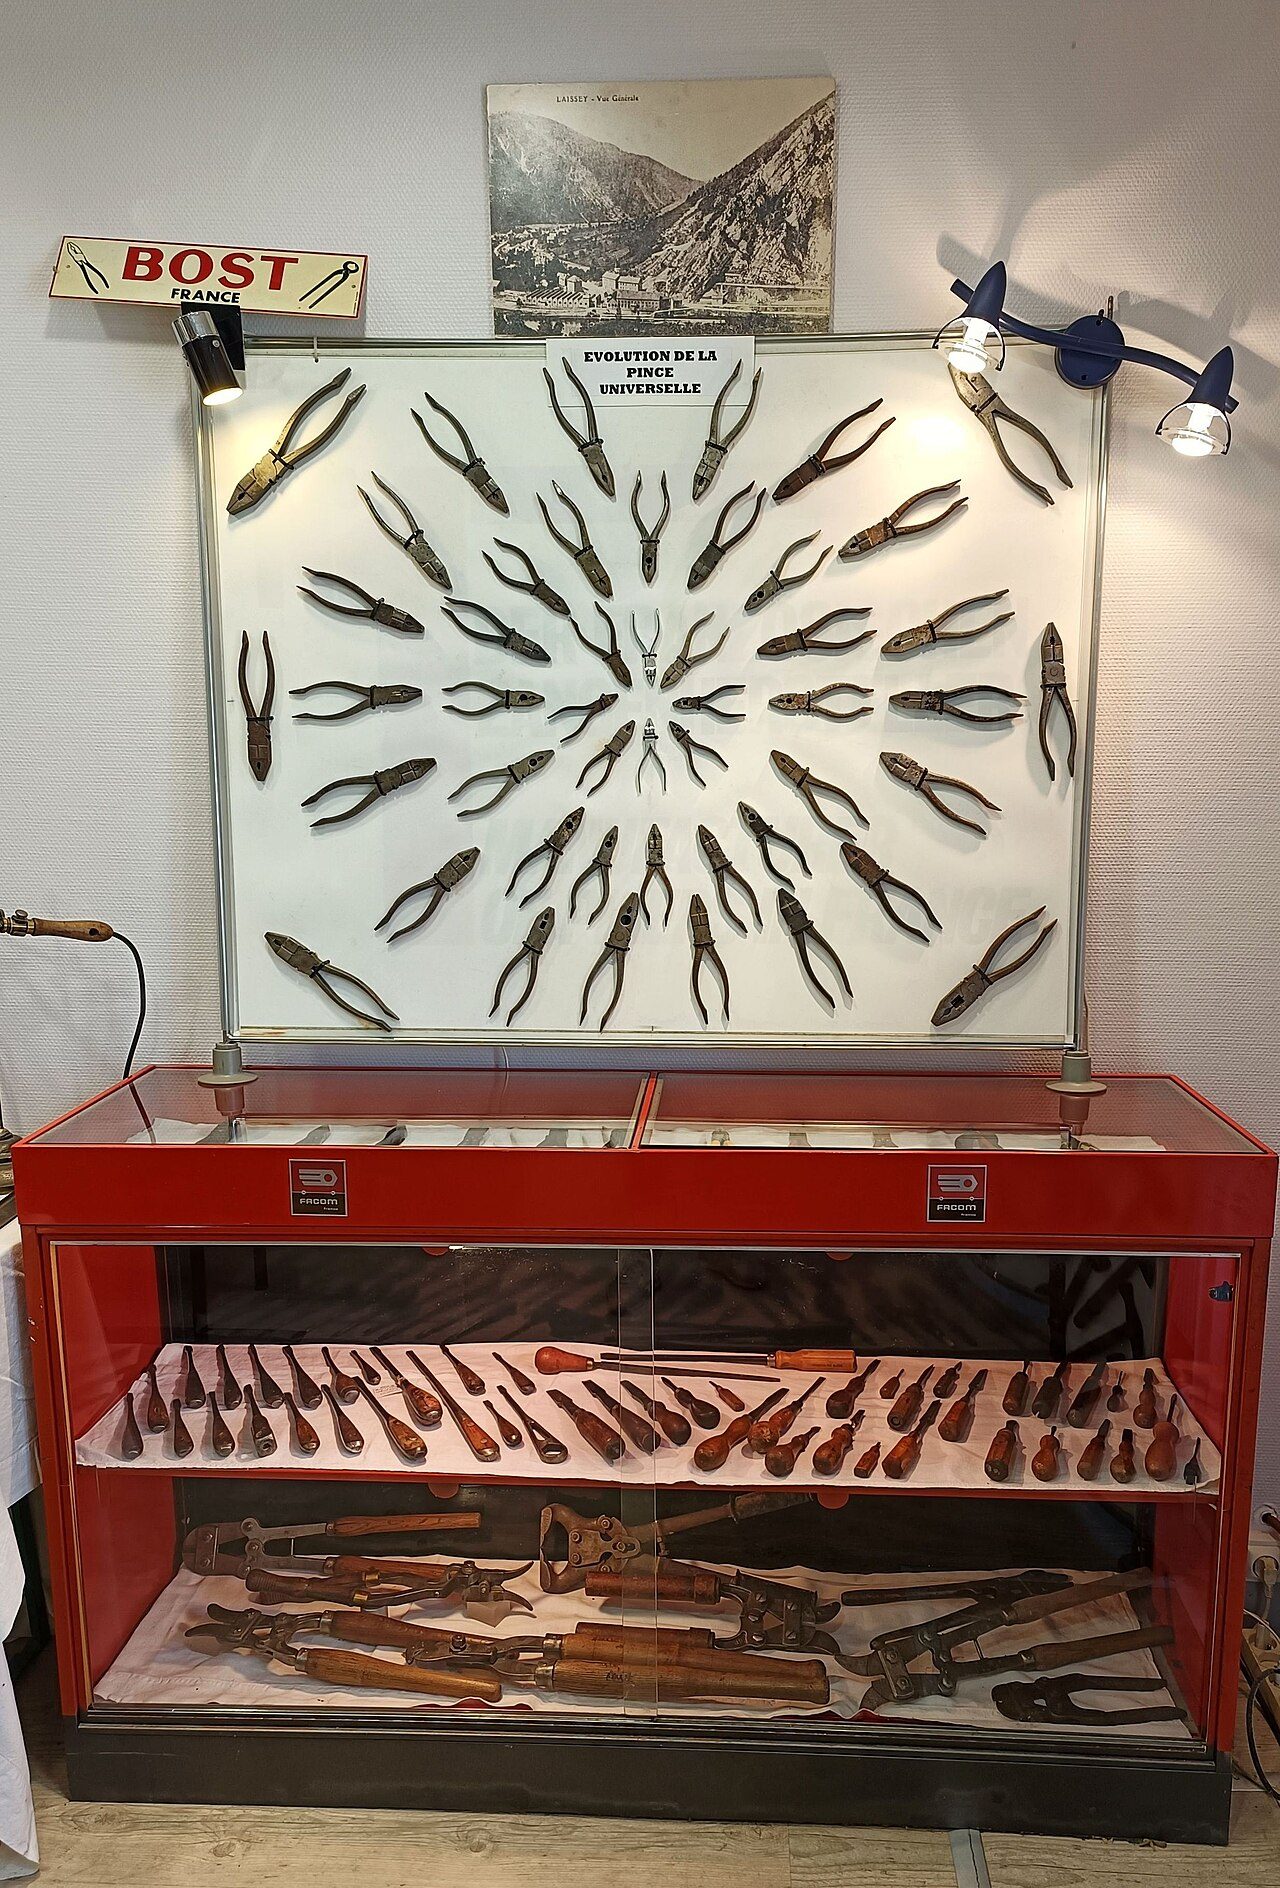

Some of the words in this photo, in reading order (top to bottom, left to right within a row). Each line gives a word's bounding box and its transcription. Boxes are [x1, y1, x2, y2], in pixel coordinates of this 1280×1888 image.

[556, 95, 588, 103] LAISSEY
[596, 94, 610, 102] Vue
[121, 245, 299, 291] BOST
[170, 287, 241, 304] FRANCE
[583, 351, 670, 363] EVOLUTION
[673, 350, 695, 362] DE
[698, 350, 718, 362] LA
[626, 367, 674, 378] PINCE
[599, 383, 702, 395] UNIVERSELLE
